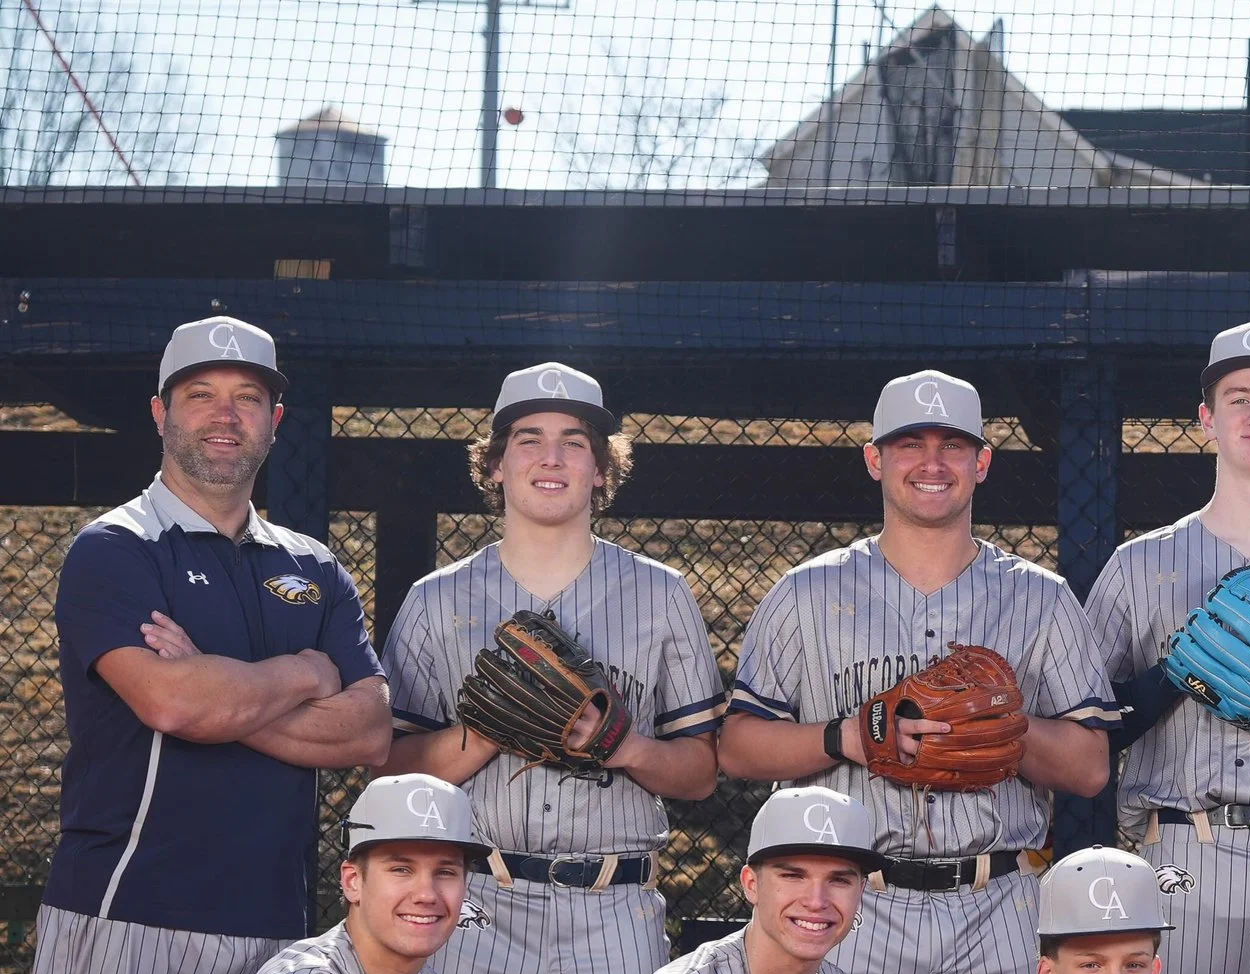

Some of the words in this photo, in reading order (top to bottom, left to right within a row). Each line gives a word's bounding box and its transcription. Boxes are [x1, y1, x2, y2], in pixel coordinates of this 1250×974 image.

[208, 323, 244, 361] CA
[537, 370, 571, 399] CA
[915, 381, 950, 418] CA
[871, 701, 883, 743] Wilson
[406, 788, 447, 830] CA
[803, 803, 840, 844] CA
[1087, 876, 1129, 920] CA
